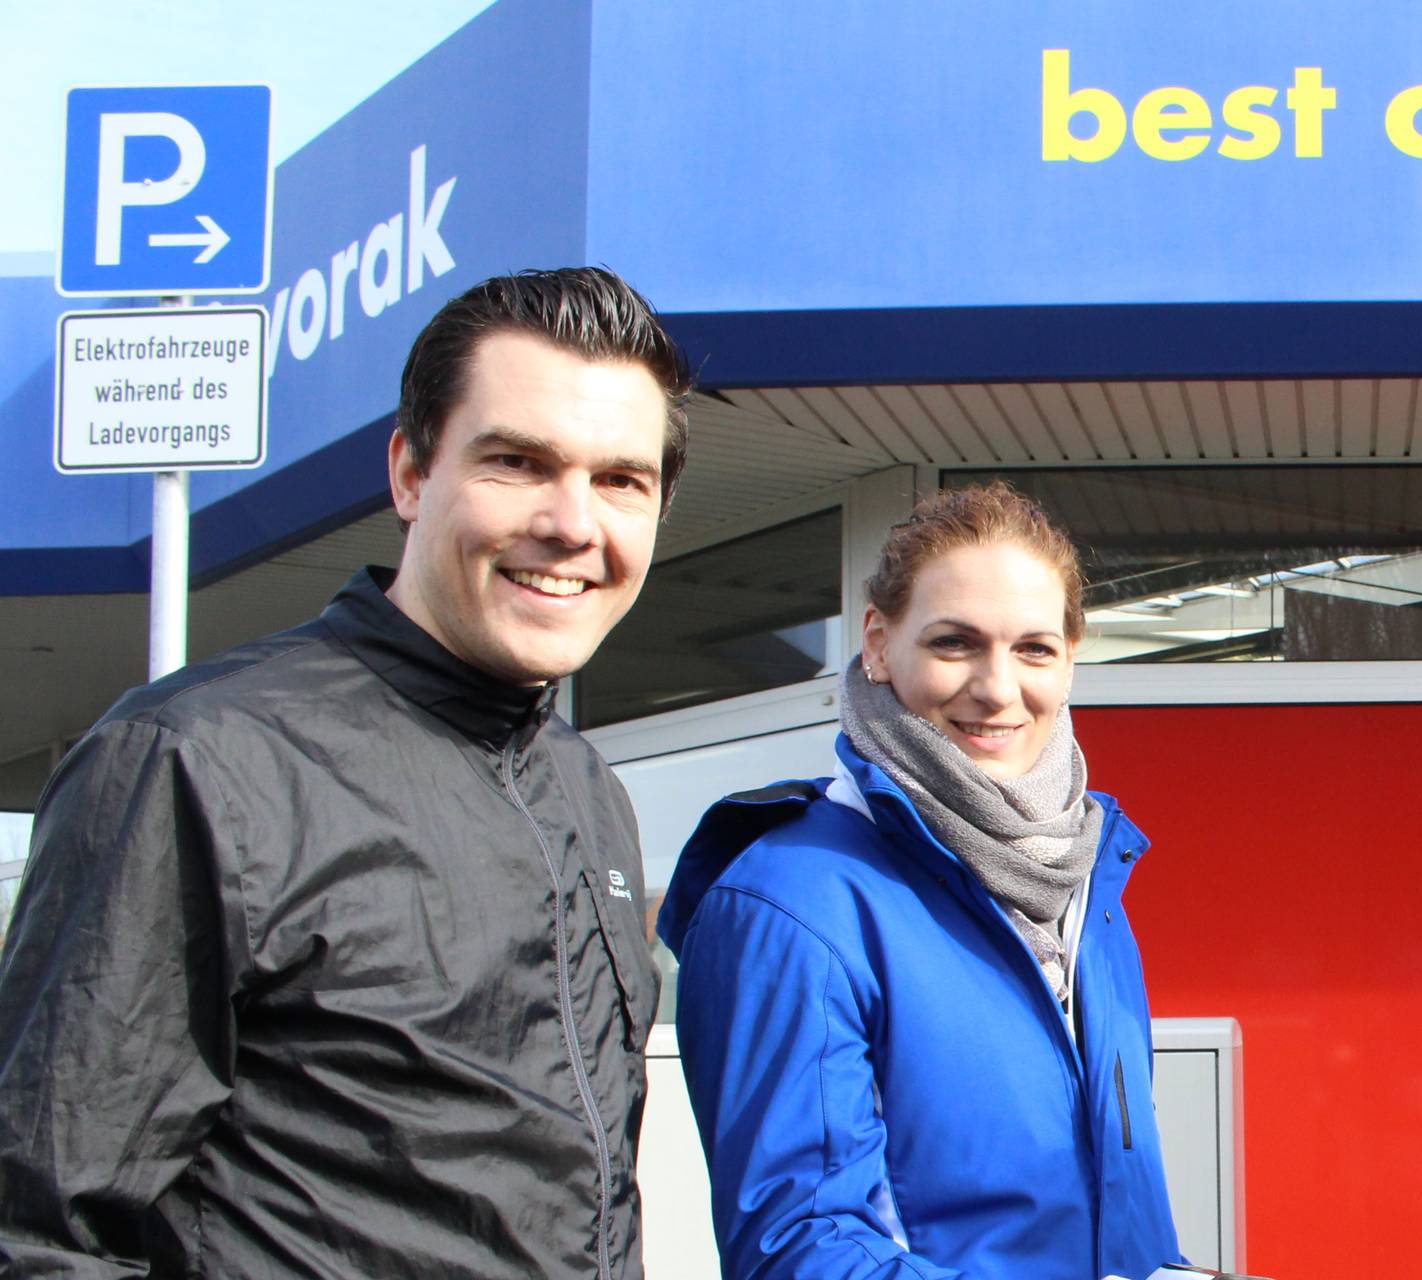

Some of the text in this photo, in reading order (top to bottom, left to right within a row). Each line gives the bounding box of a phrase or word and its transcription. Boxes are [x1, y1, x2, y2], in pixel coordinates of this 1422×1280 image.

[1041, 48, 1336, 163] best
[95, 112, 206, 266] P
[74, 335, 250, 364] Elektrofahrzeuge
[95, 376, 228, 403] während des
[89, 420, 231, 449] Ladevorgangs
